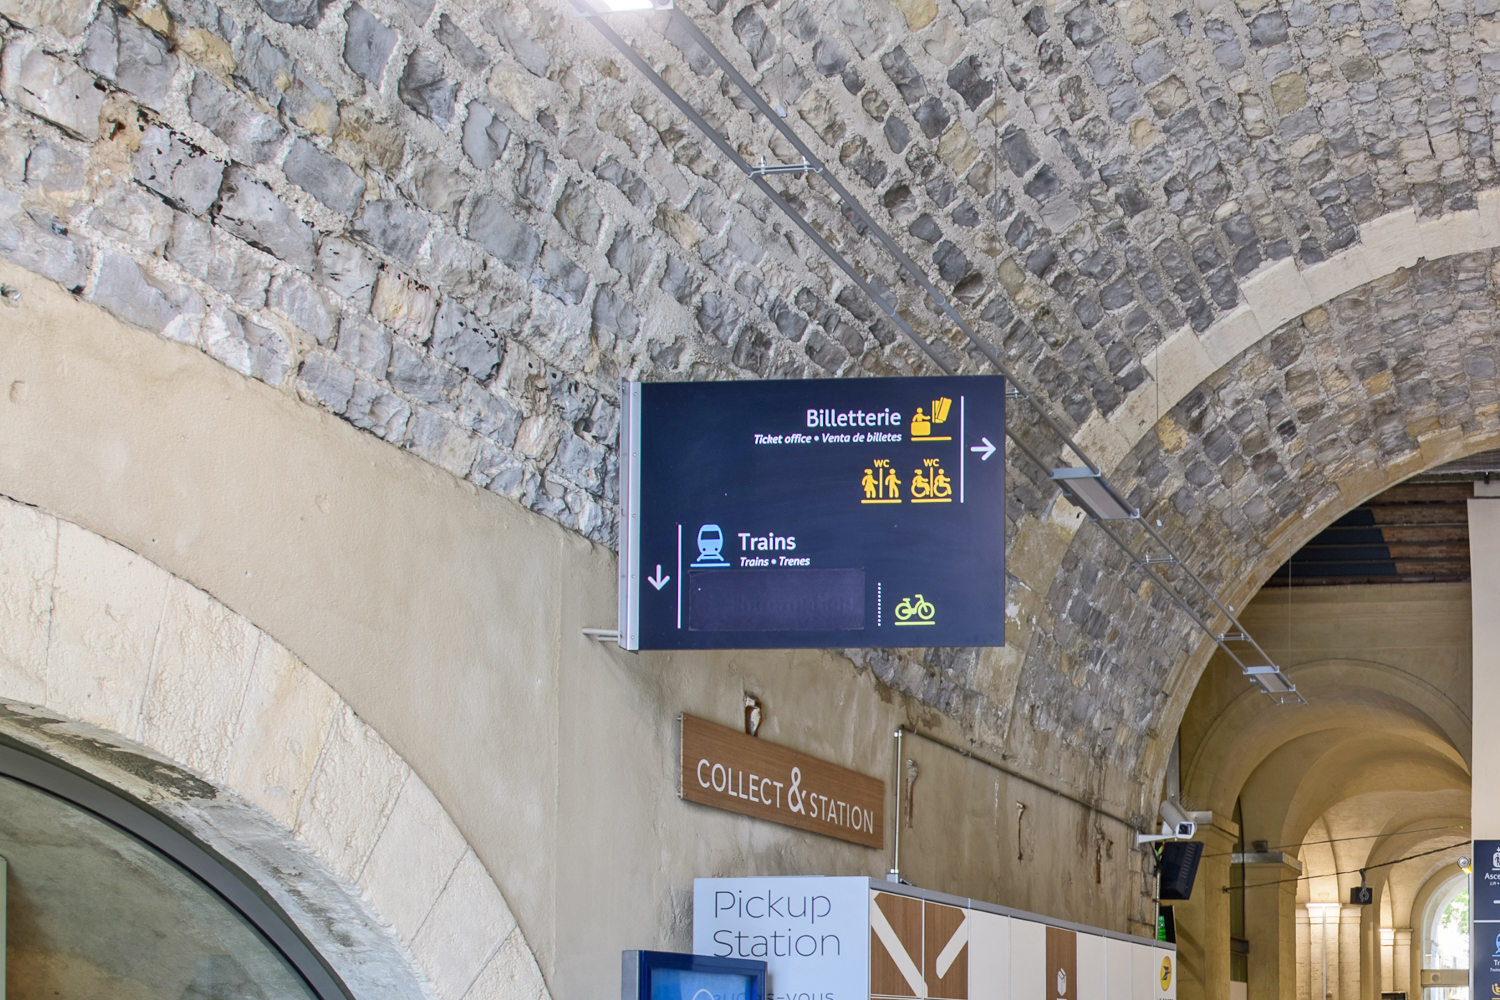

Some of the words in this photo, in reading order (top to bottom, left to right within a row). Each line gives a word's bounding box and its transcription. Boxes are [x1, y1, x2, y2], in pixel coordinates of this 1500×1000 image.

[806, 408, 901, 427] Billetterie
[754, 434, 783, 444] Ticket
[784, 433, 812, 444] office
[822, 433, 850, 443] Venta
[852, 432, 865, 442] de
[866, 432, 902, 442] billetes
[874, 459, 890, 467] WC
[924, 458, 939, 467] WC
[737, 532, 797, 551] Trains
[740, 556, 769, 566] Trains
[779, 556, 810, 566] Trenes
[696, 759, 783, 808] COLLECT
[788, 766, 807, 815] &
[809, 792, 874, 834] STATION
[715, 889, 832, 924] Pickup
[713, 928, 840, 958] Station
